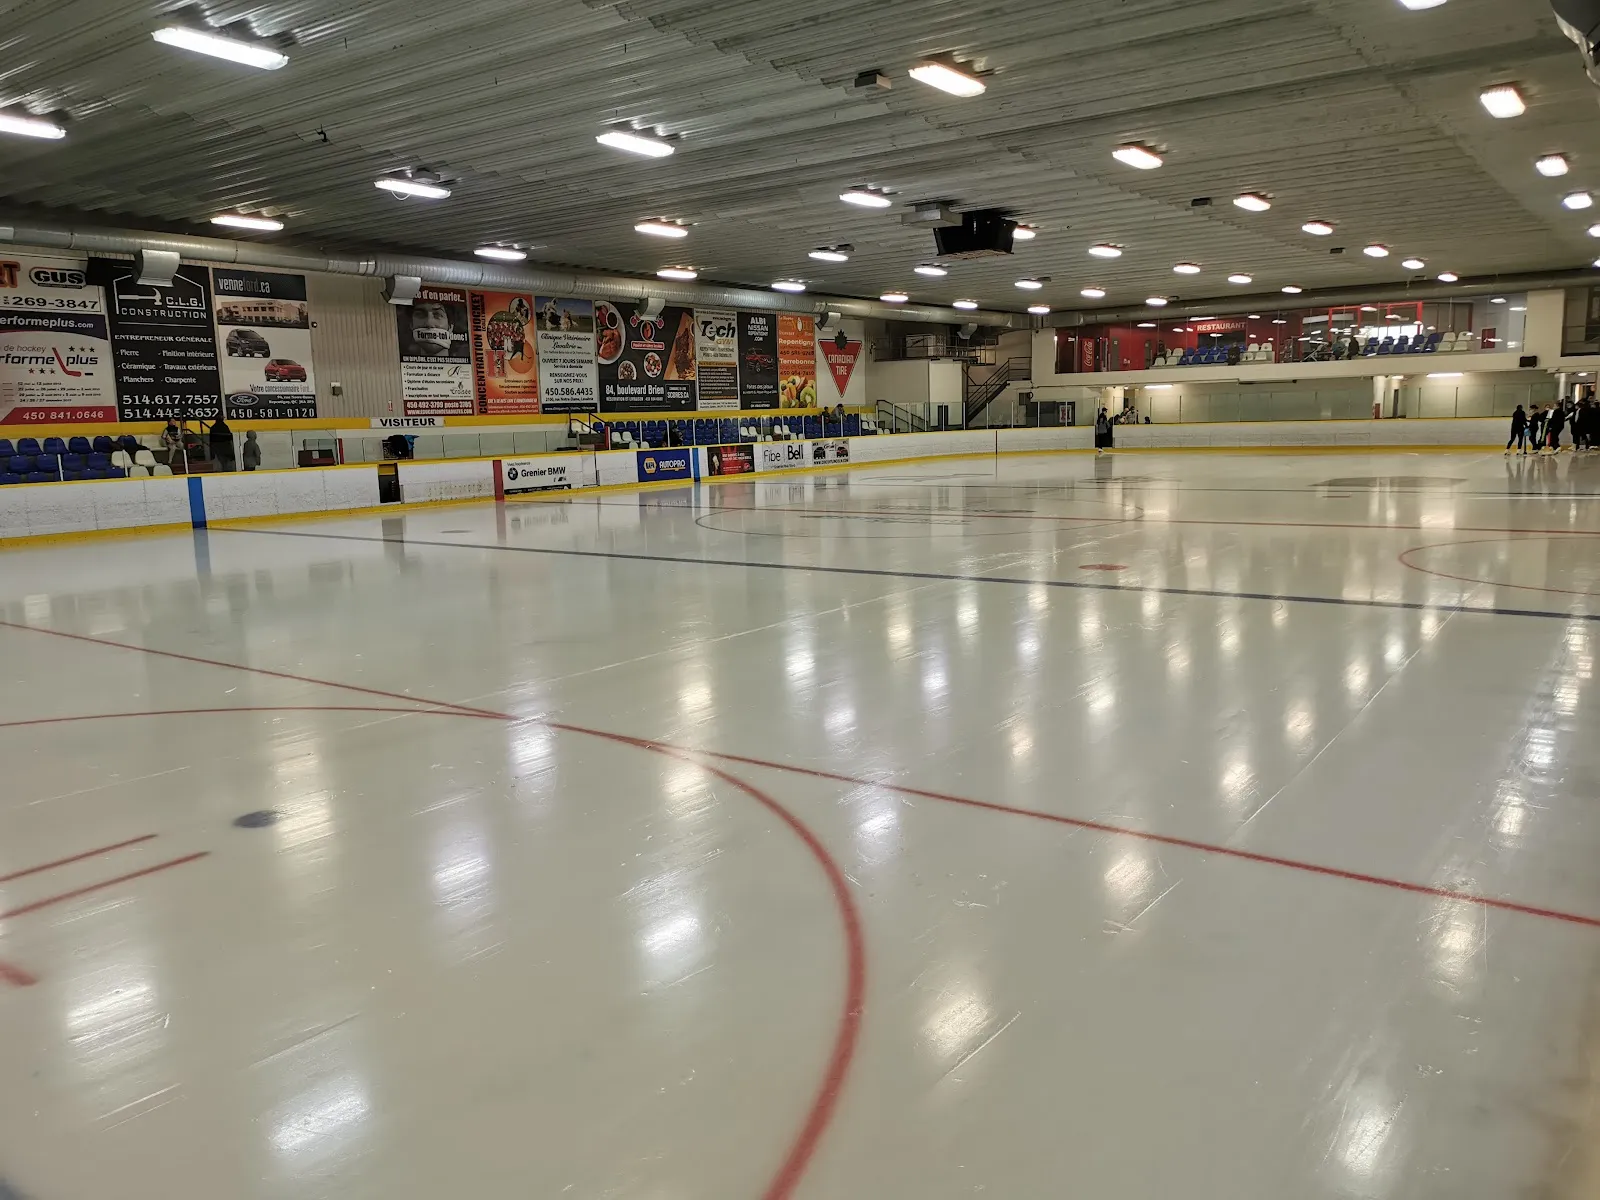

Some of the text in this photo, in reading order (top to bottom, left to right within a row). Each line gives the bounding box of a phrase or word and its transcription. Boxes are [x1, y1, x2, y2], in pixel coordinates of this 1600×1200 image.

[34, 270, 84, 285] GUS
[218, 277, 270, 294] venneford.ca
[422, 290, 438, 300] d'en
[12, 296, 98, 309] 269-3847
[166, 296, 202, 306] C.L.G.
[121, 307, 207, 319] CONSTRUCTION
[750, 317, 766, 325] ALBI
[701, 320, 735, 338] Tech
[1197, 322, 1246, 331] RESTAURANT
[417, 331, 447, 340] Forme-toi
[450, 333, 464, 341] donc
[541, 333, 562, 342] Clinique
[779, 338, 814, 346] Repentigny
[17, 345, 46, 354] hockey
[471, 292, 488, 414] CONCENTRATION HOCKEY
[1084, 341, 1092, 367] Coca-Cola
[66, 354, 98, 366] plus
[828, 354, 854, 364] CANADIAN
[121, 363, 156, 371] Céramique
[836, 366, 848, 375] TIRE
[250, 384, 264, 392] Votre
[606, 384, 664, 396] 84, boulevard Brien
[122, 395, 218, 405] 514.617.7557
[23, 411, 104, 420] 450 841.0646
[230, 408, 315, 418] 450-581-0120
[380, 418, 435, 426] VISITEUR
[788, 444, 804, 460] Bell
[659, 460, 686, 469] AUTOPRO
[521, 466, 566, 478] Grenier BMW
